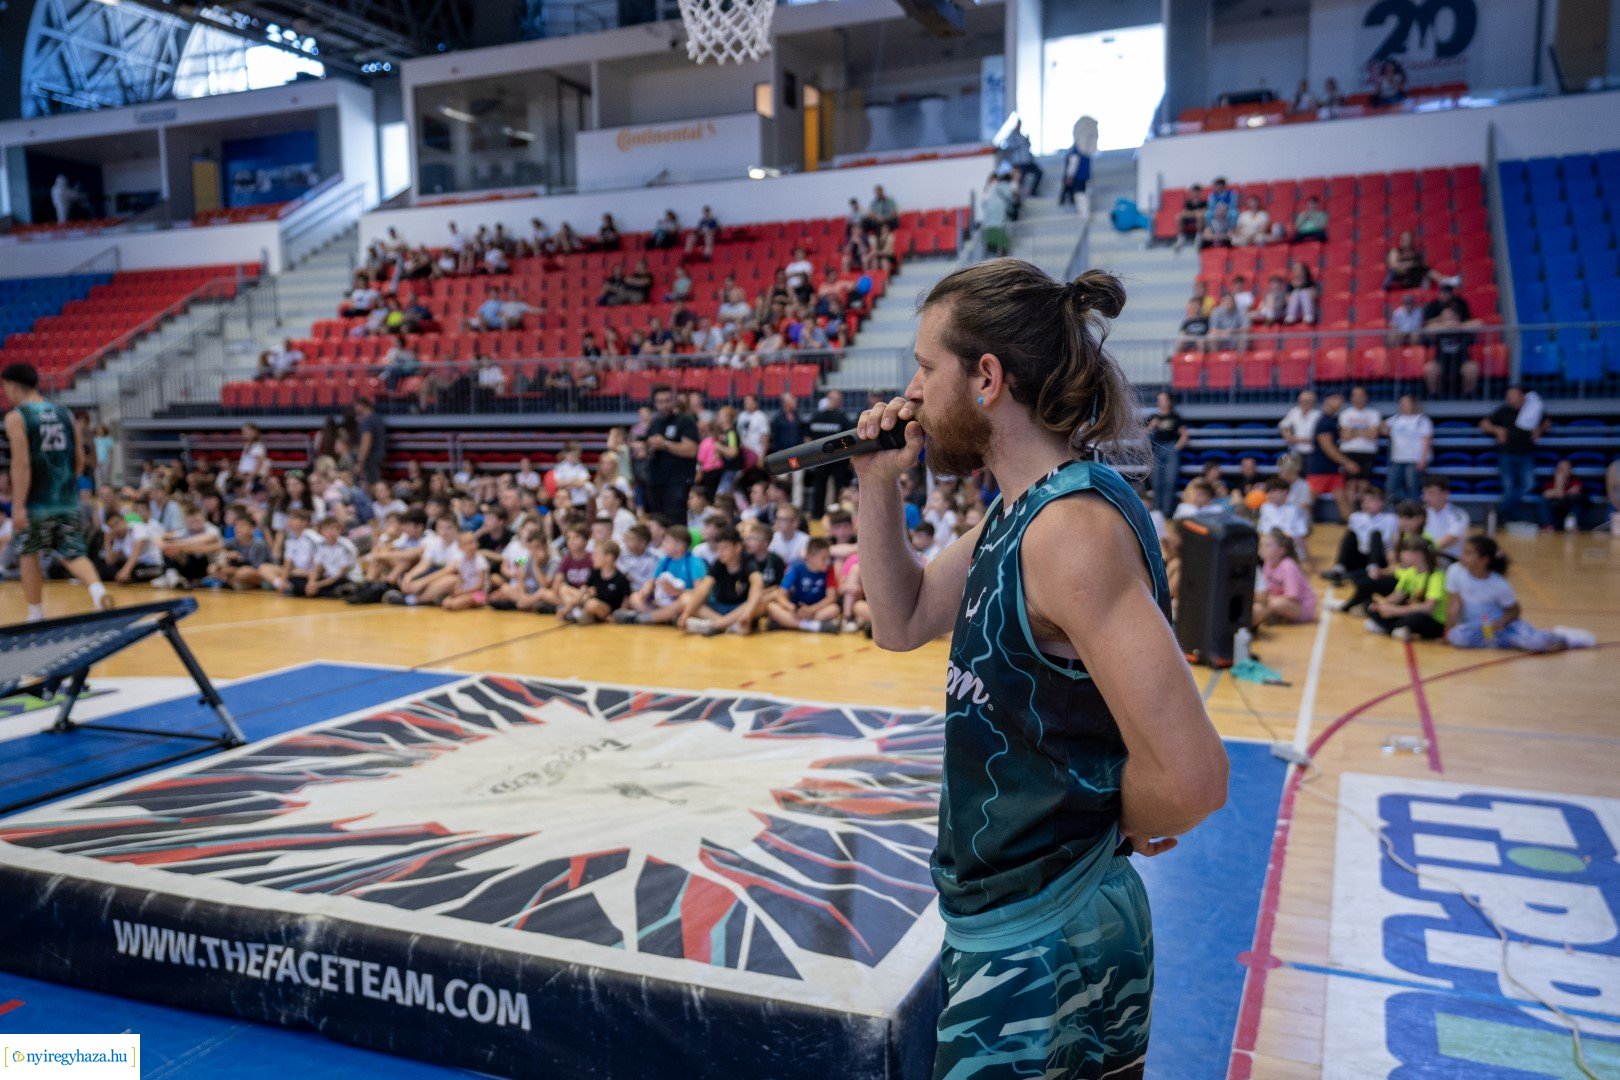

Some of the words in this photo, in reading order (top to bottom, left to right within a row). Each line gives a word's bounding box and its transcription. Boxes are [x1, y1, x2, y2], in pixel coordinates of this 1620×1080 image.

[616, 121, 704, 153] Continental
[39, 421, 68, 453] 25
[112, 918, 532, 1031] WWW.THEFACETEAM.COM
